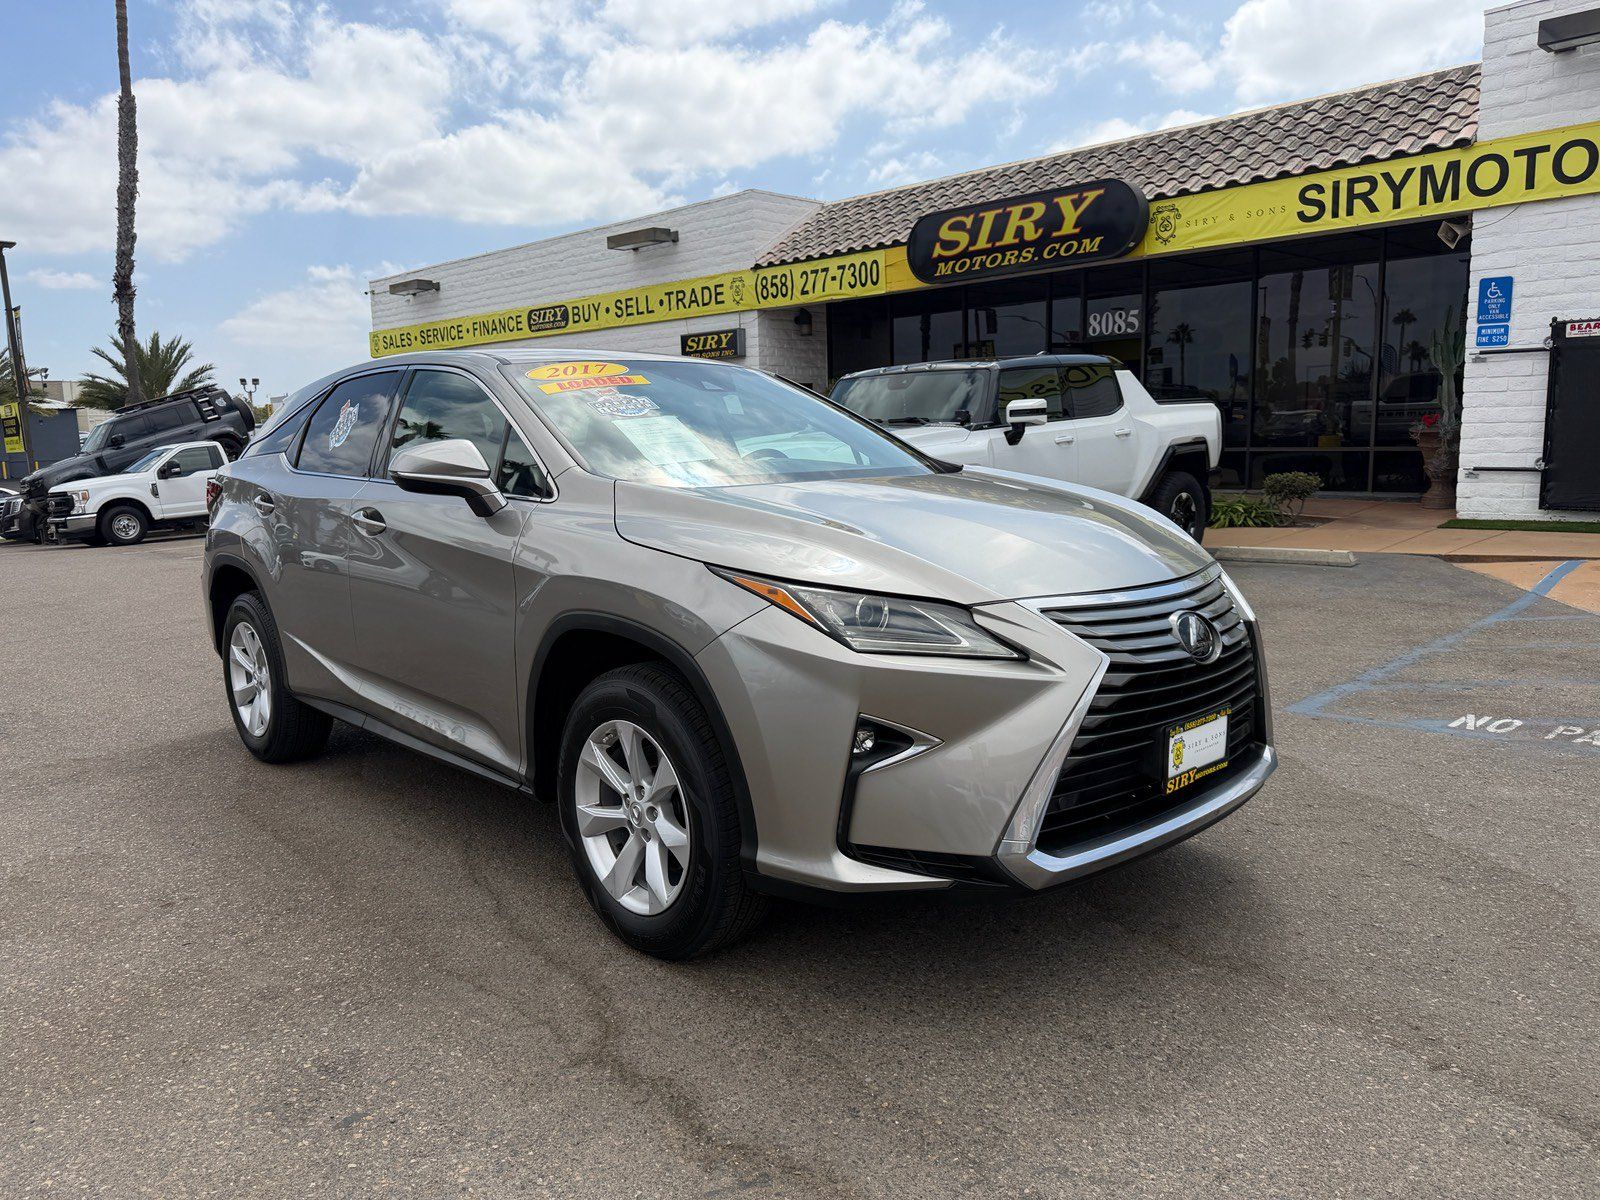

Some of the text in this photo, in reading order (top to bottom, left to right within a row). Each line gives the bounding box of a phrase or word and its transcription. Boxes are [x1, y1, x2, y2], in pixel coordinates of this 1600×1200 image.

[1297, 138, 1599, 223] SIRYMOTO
[932, 188, 1106, 259] SIRY
[1185, 205, 1286, 228] SIRY & SONS
[935, 236, 1104, 277] MOTORS.COM
[755, 259, 880, 304] (858) 277-7300
[530, 307, 566, 325] SIRY
[572, 284, 726, 324] BUY SELL TRADE
[382, 315, 523, 350] SALES SERVICE FINANCE
[1088, 309, 1139, 337] 8085
[1481, 327, 1505, 335] MINIMUM
[685, 332, 733, 352] SIRY
[1477, 335, 1508, 344] FINE $250
[545, 363, 608, 379] 2017
[556, 375, 635, 391] LOADED
[1447, 713, 1523, 733] NO
[1166, 768, 1198, 795] SIRY
